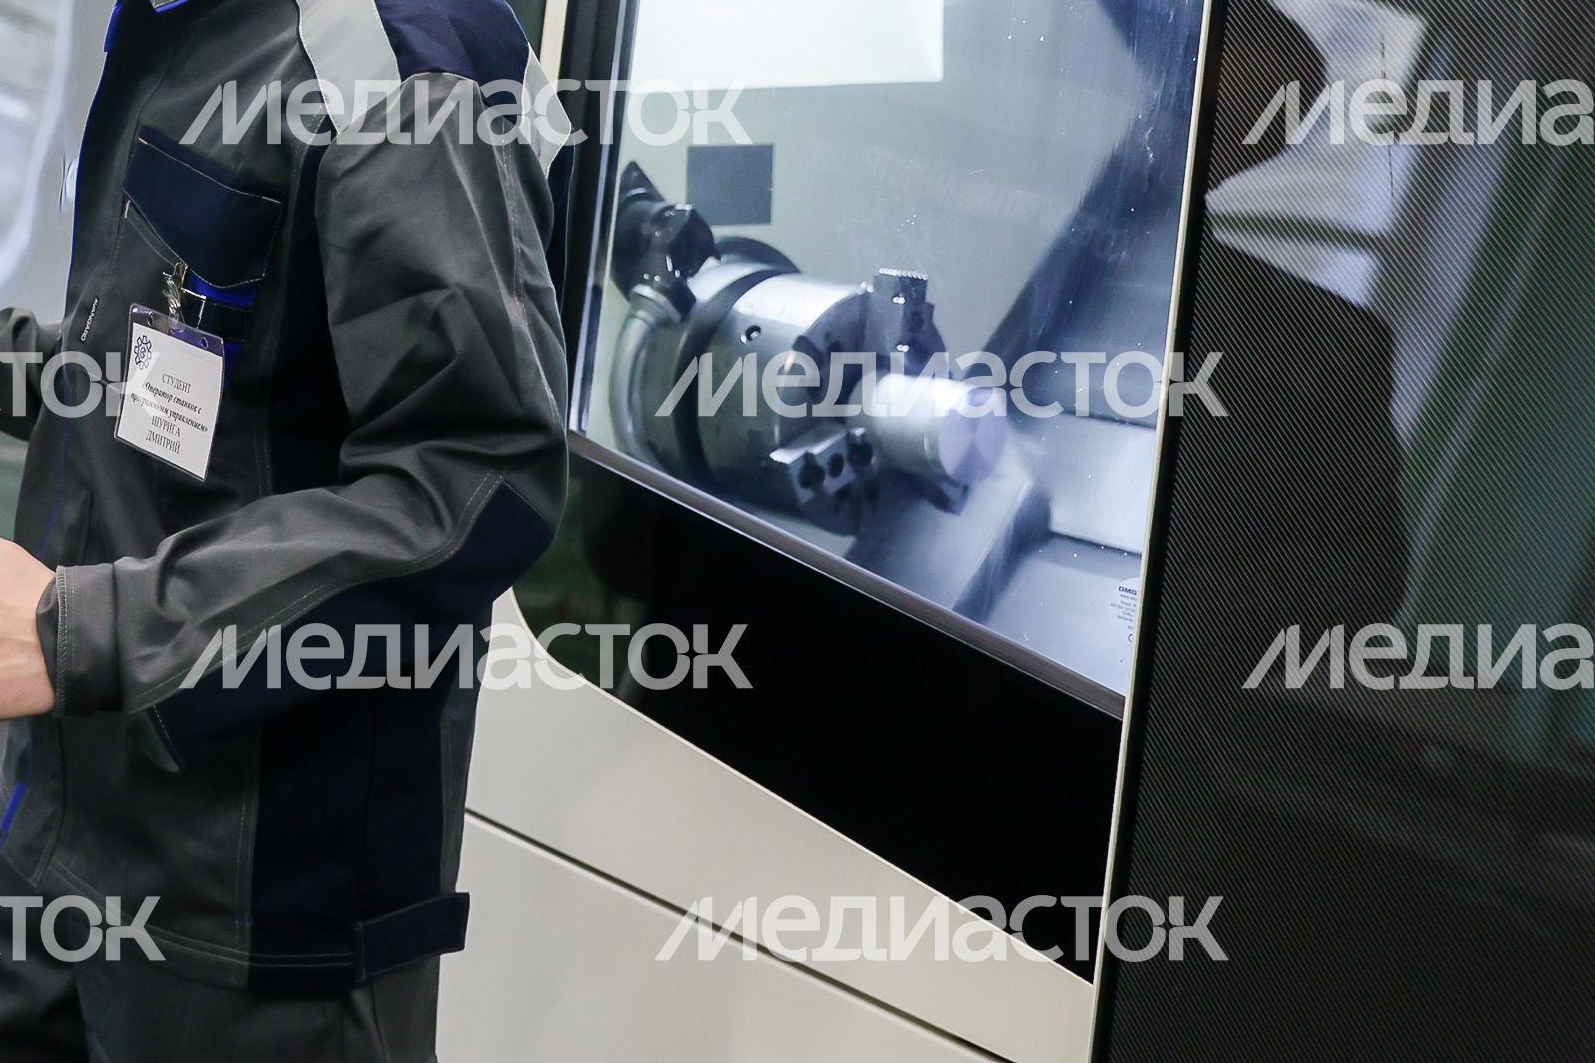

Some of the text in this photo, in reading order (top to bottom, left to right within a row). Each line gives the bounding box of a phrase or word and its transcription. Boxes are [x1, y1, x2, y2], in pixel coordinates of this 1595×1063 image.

[162, 373, 191, 393] СТУДЕНТ
[152, 415, 180, 437] ШУРИГА
[146, 429, 181, 454] ДМИТРИЙ
